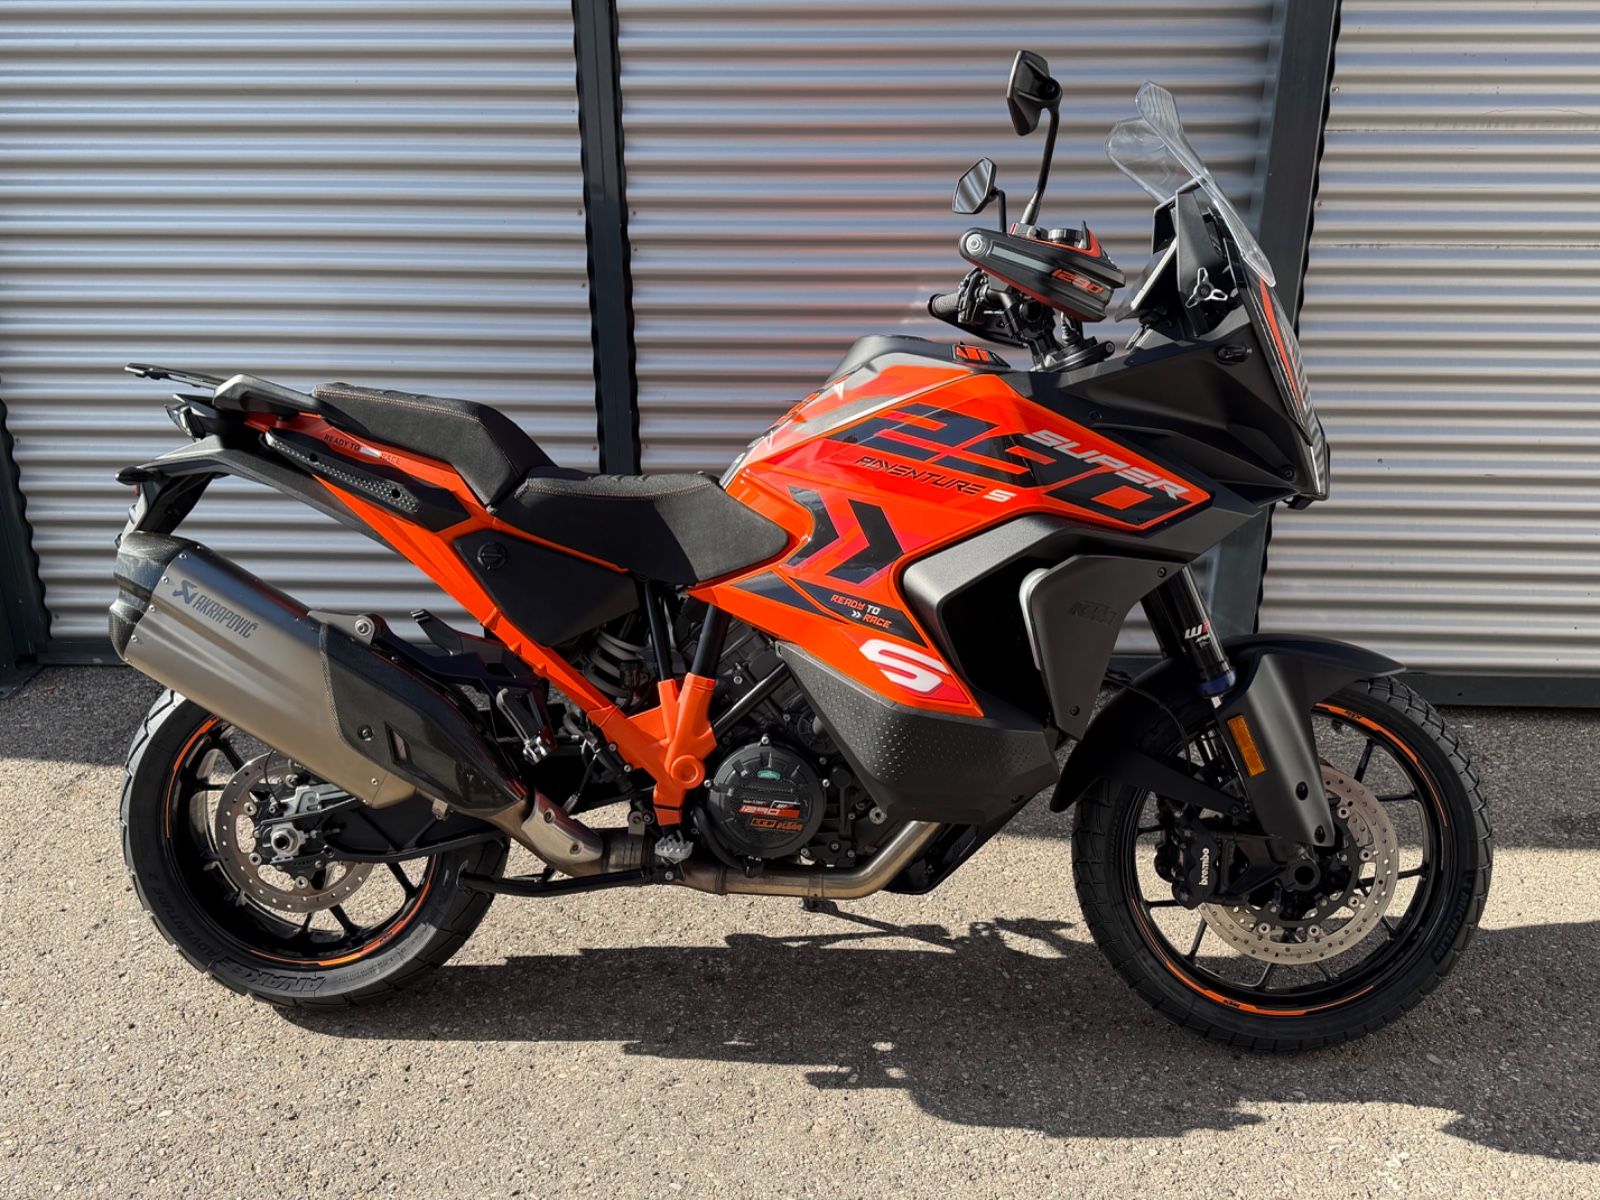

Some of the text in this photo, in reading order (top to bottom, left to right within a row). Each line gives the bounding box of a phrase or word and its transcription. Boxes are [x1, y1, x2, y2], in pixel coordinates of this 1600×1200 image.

[1051, 268, 1105, 296] 1290
[324, 434, 348, 448] READY
[855, 455, 1019, 503] ADVENTURE S
[1023, 429, 1191, 502] SUPER
[831, 594, 881, 616] READY TO
[862, 613, 893, 629] RACE
[858, 638, 951, 693] S
[1198, 847, 1210, 886] brembo
